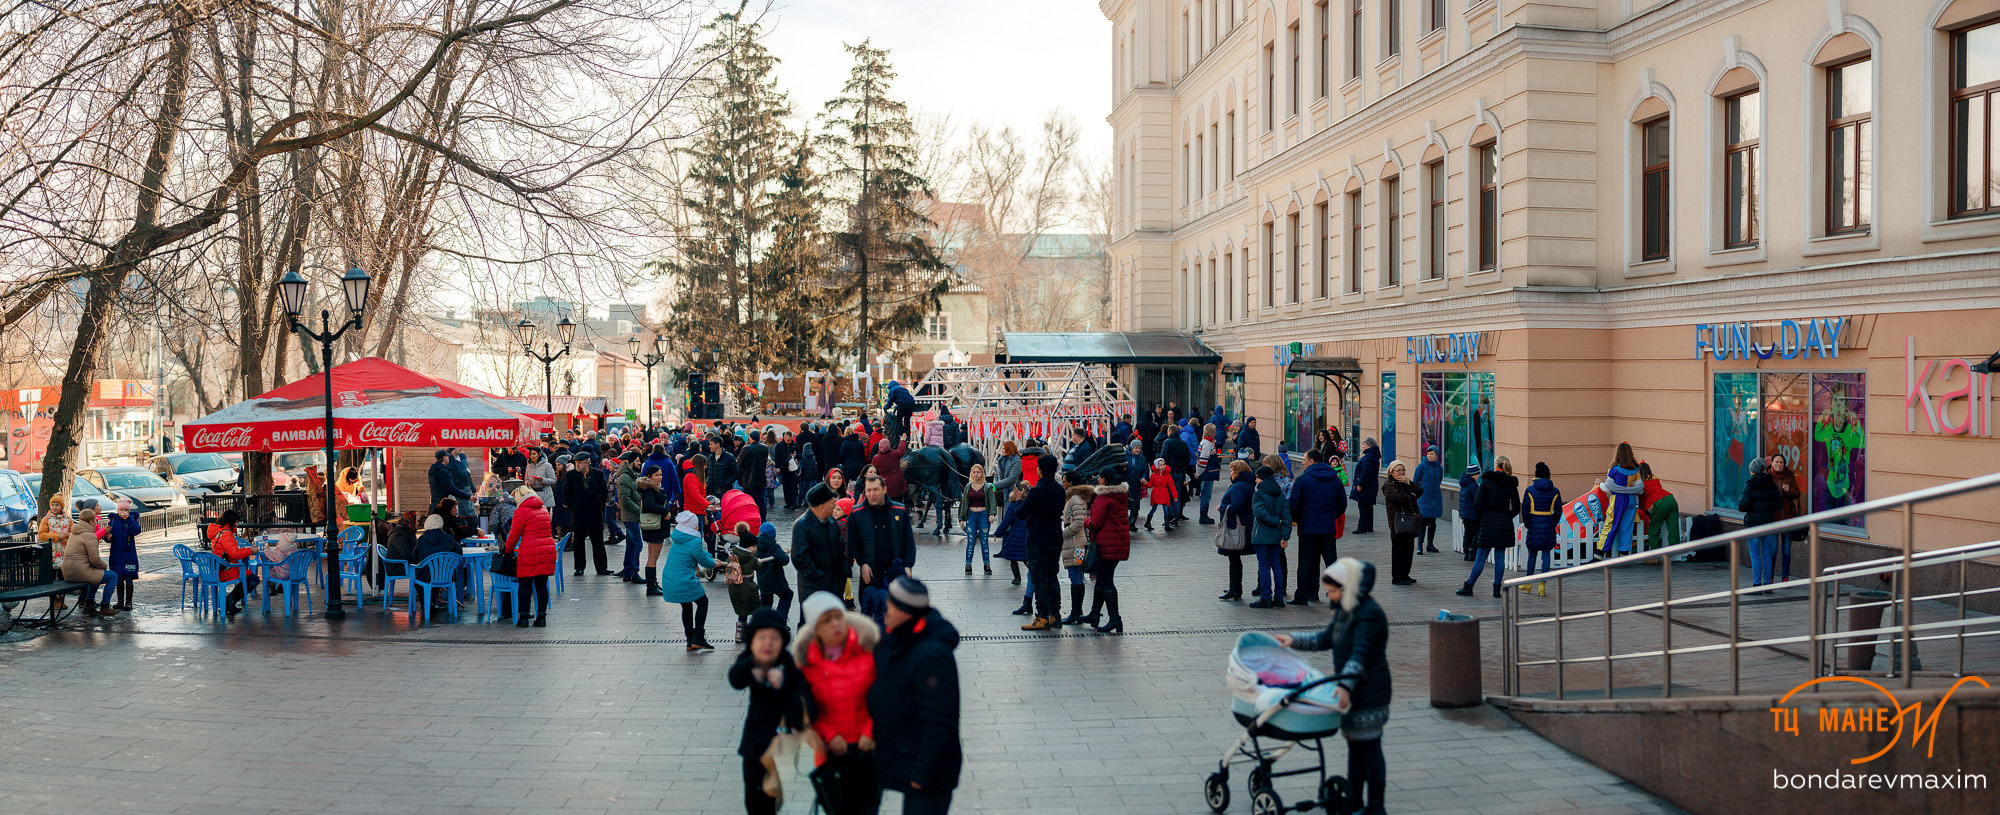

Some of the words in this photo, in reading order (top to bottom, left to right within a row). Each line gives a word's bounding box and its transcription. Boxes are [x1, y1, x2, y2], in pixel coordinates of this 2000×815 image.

[1406, 335, 1436, 365] FUN
[1449, 331, 1481, 363] DAY
[1696, 322, 1753, 361] FUN
[1771, 317, 1846, 360] DAY
[1274, 345, 1291, 366] FUN
[192, 426, 254, 449] Coca-Cola
[272, 426, 343, 442] ВЛИВАЙЯ!
[359, 421, 424, 443] Coca-Cola
[441, 426, 514, 441] ВЛИВАЙСЯ!
[1453, 426, 1467, 444] 699
